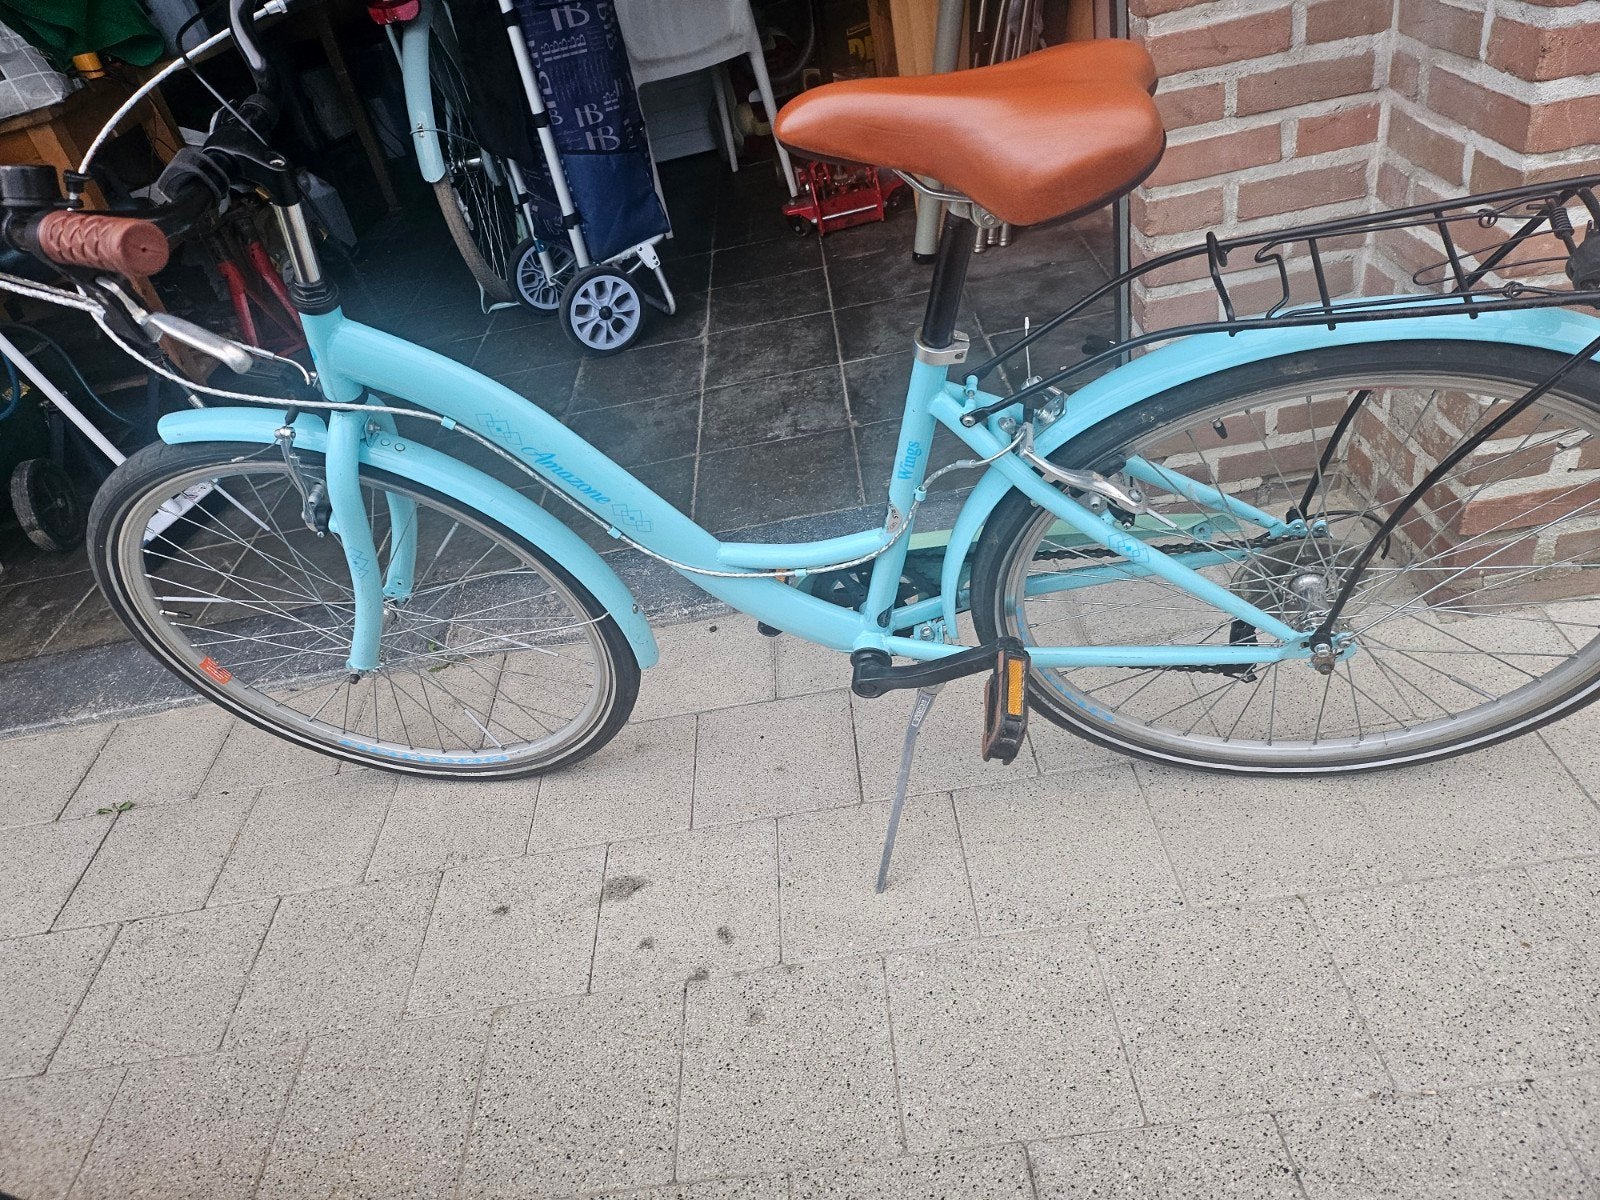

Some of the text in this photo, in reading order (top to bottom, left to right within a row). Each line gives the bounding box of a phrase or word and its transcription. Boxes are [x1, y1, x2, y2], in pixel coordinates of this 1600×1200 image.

[575, 103, 604, 127] IB
[585, 126, 621, 151] IB
[521, 446, 611, 505] Amazone
[897, 440, 922, 480] Wings
